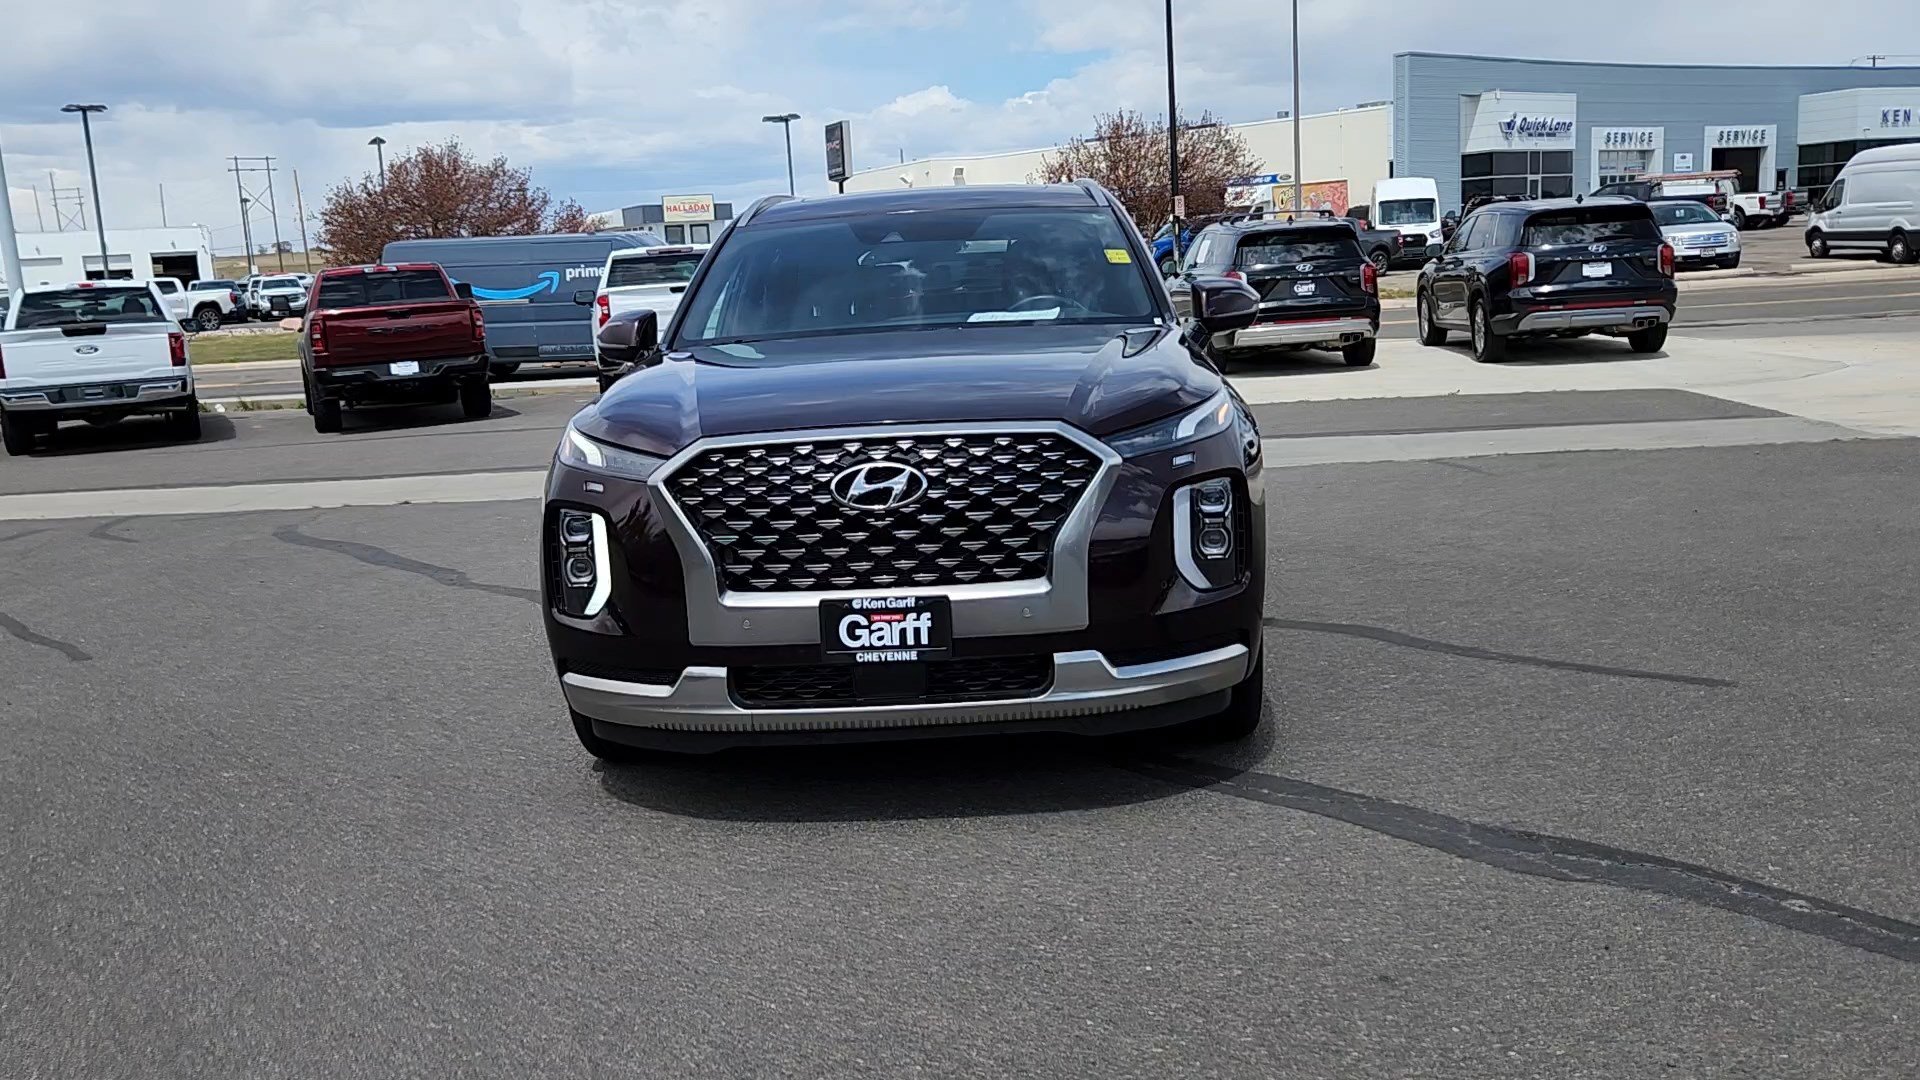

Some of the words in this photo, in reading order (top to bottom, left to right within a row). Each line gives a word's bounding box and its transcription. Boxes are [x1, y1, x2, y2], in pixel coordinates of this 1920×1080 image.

[1881, 108, 1911, 122] KEN
[1519, 116, 1548, 134] Quick
[1548, 117, 1573, 132] Lane
[1605, 131, 1654, 144] SERVICE
[1719, 129, 1767, 142] SERVICE
[665, 203, 711, 213] HALLADAY
[565, 264, 605, 282] prime
[838, 612, 932, 648] Garff
[856, 651, 918, 662] CHEYENNE
